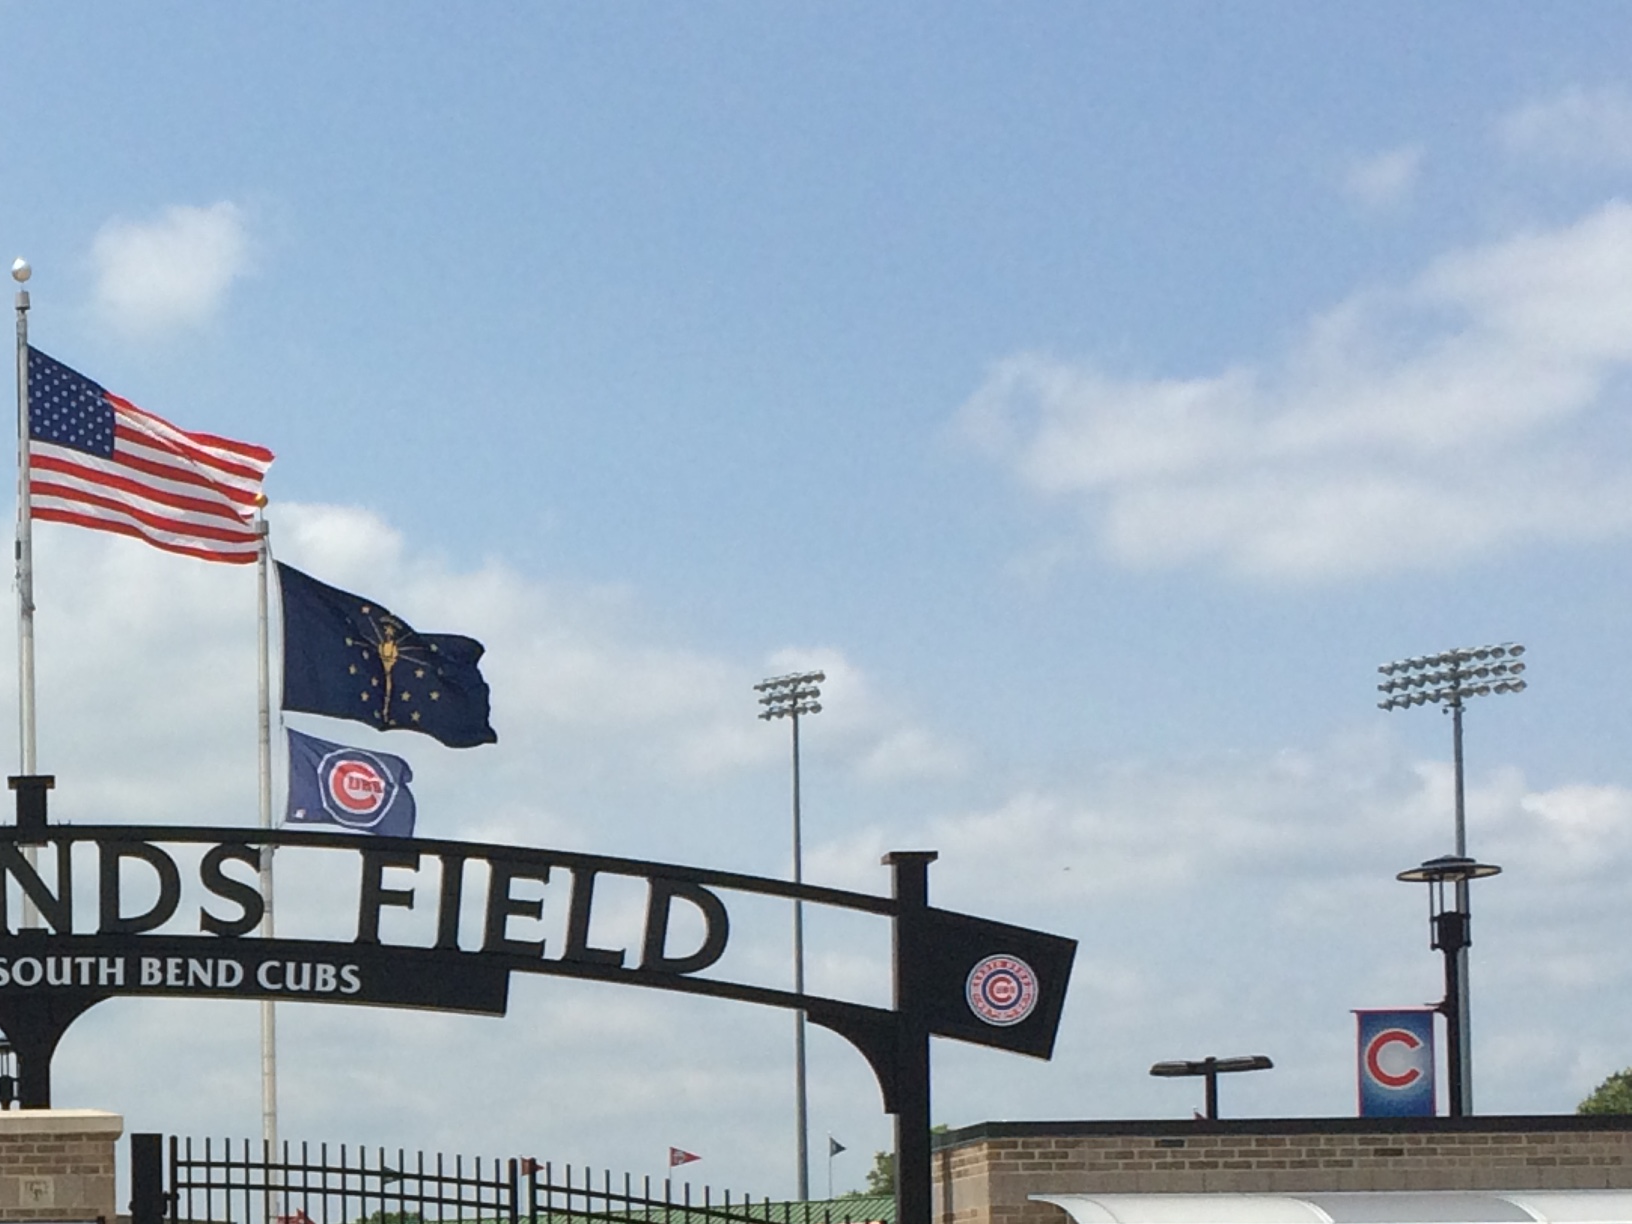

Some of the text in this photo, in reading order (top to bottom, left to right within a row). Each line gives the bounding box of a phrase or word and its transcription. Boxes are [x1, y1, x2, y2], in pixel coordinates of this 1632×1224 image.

[355, 849, 729, 975] FIELD
[140, 958, 243, 988] BEND
[257, 960, 361, 994] CUBS
[1366, 1029, 1422, 1089] C
